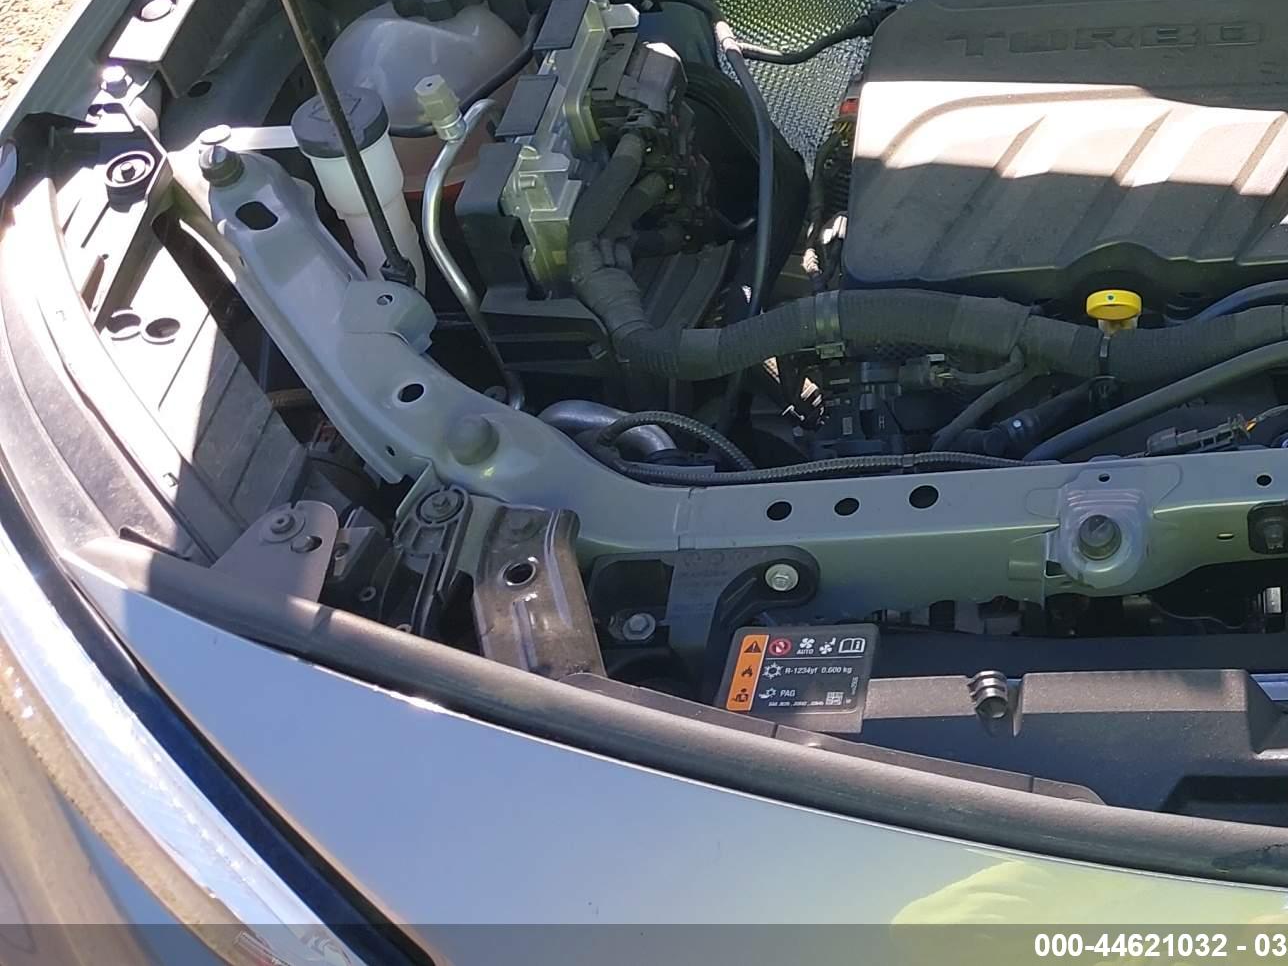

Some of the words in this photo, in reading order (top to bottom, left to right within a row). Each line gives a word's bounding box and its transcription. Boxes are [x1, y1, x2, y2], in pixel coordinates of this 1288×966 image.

[944, 22, 1264, 55] TURBO
[785, 666, 818, 675] R-1234yf
[843, 666, 853, 675] kg
